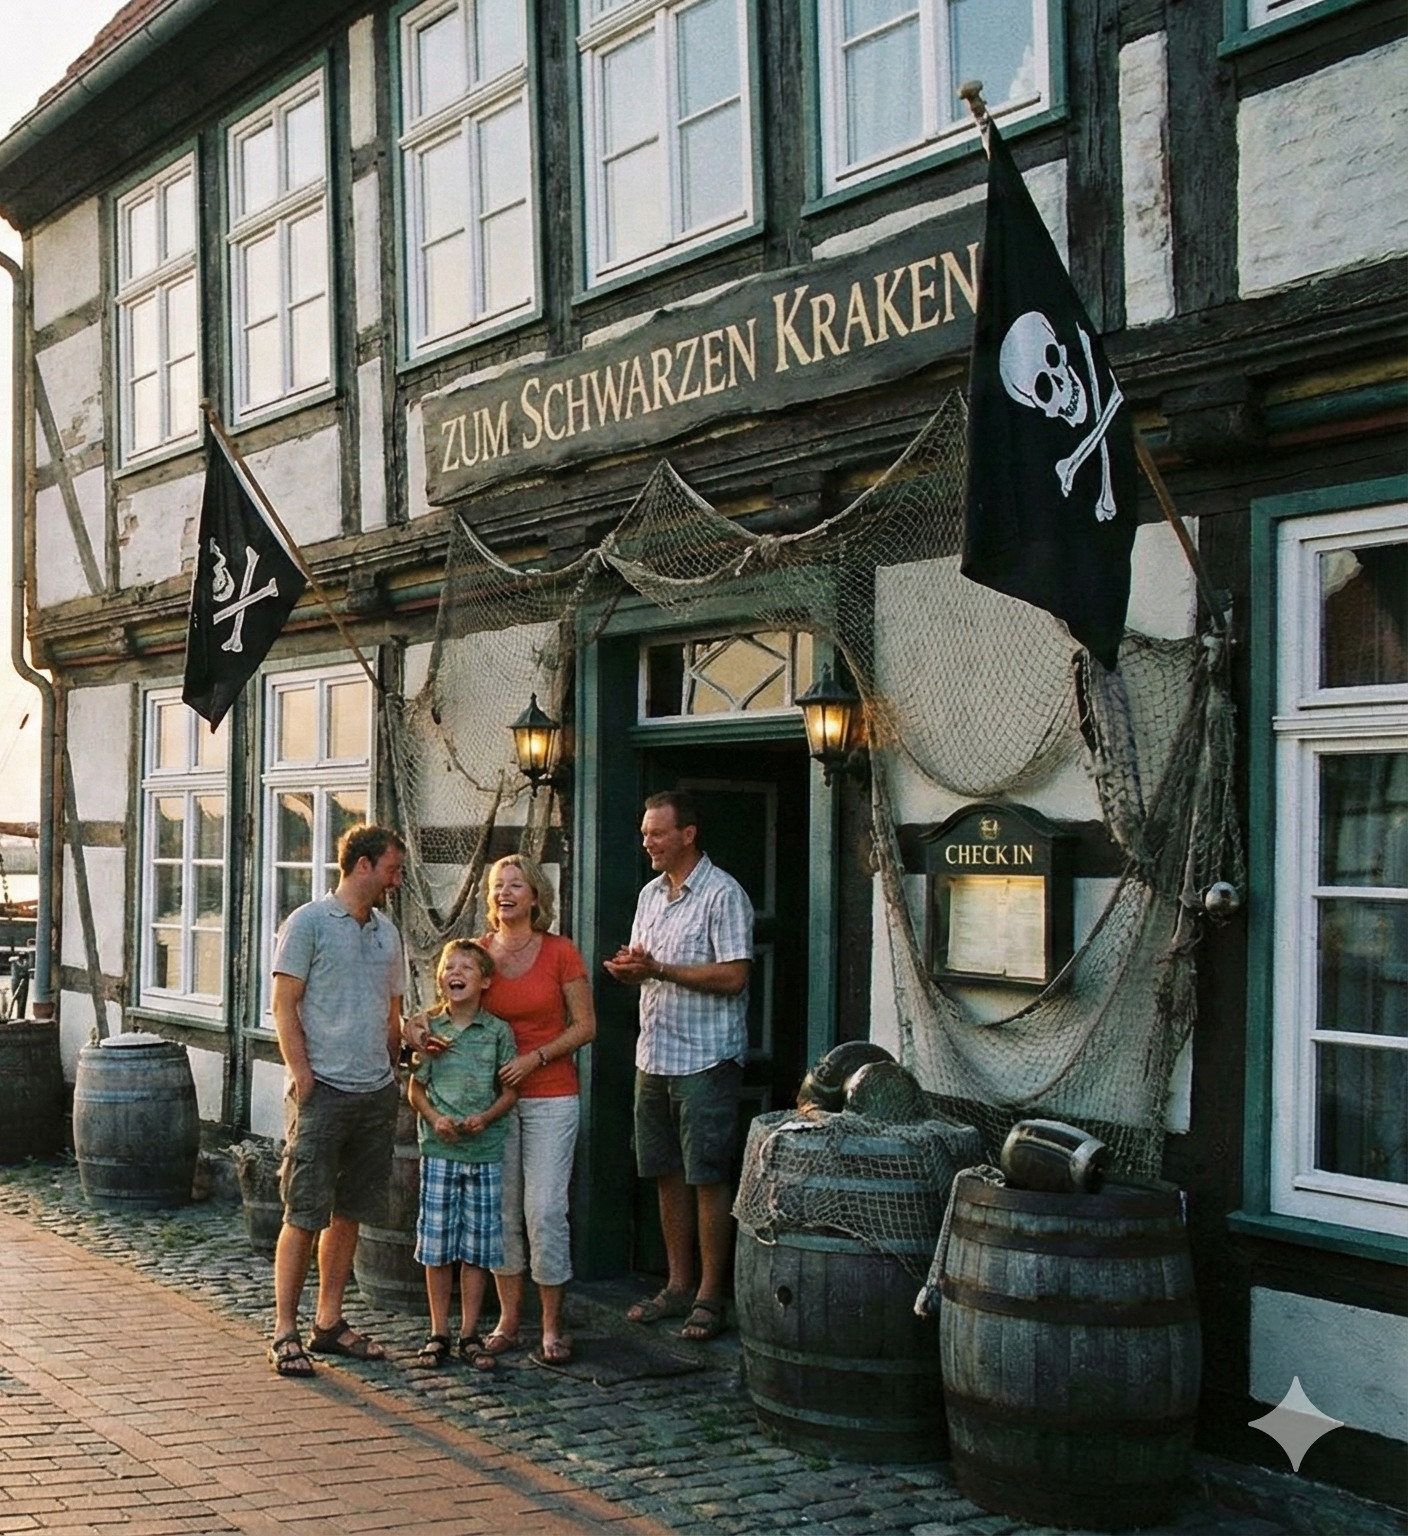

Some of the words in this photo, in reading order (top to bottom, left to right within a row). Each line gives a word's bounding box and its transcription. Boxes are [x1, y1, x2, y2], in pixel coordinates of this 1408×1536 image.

[440, 400, 510, 474] ZUM
[521, 319, 758, 448] SCHWARZEN
[772, 241, 981, 374] KRAKEN
[944, 844, 1010, 865] CHECK
[1012, 844, 1034, 865] IN
